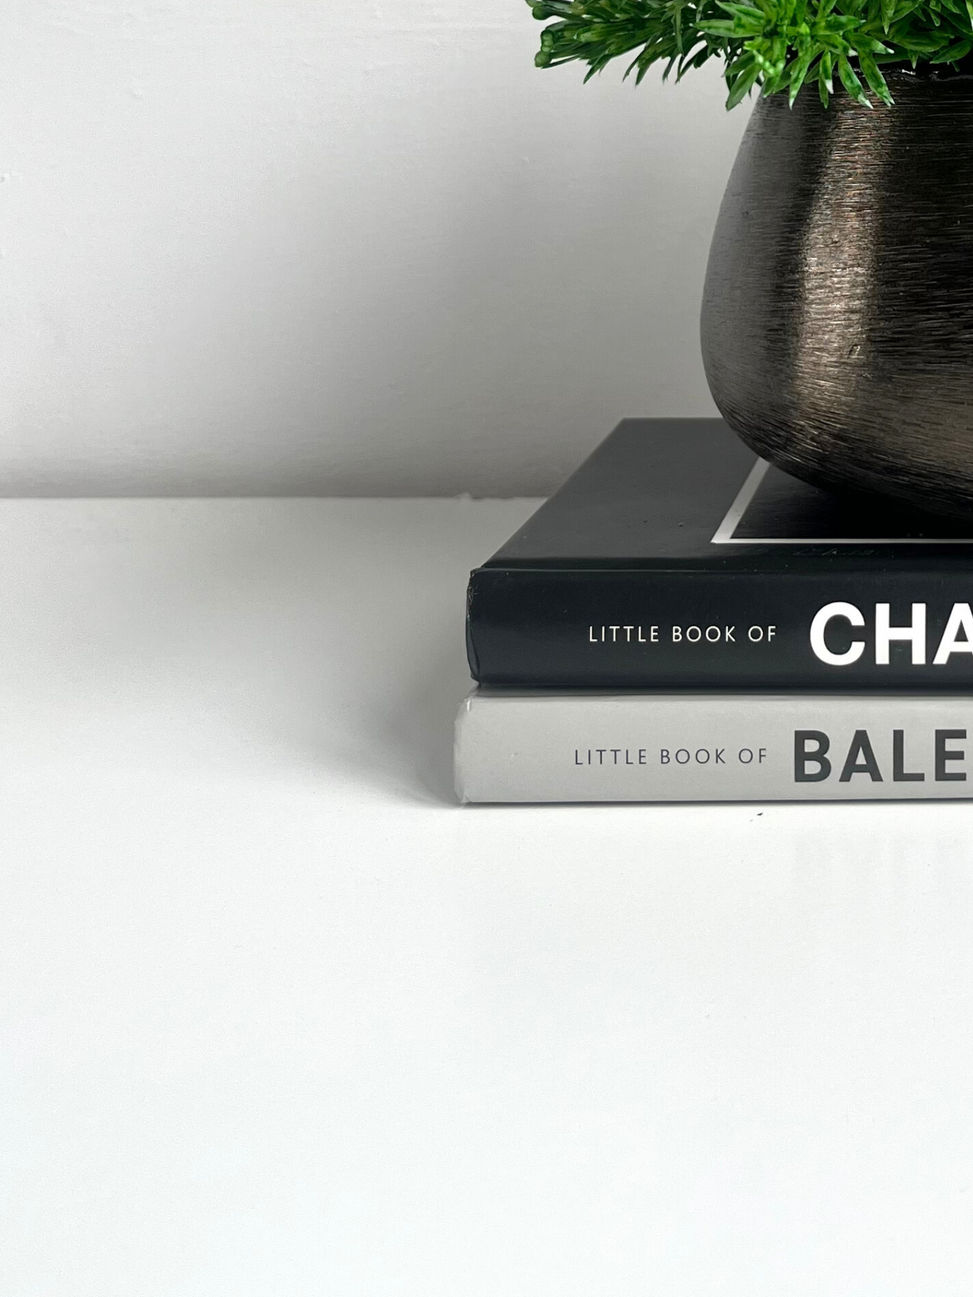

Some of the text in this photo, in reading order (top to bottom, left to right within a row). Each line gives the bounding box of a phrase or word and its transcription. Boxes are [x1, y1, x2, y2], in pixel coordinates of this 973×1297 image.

[589, 625, 776, 643] LITTLE BOOK OF
[575, 747, 767, 766] LITTLE BOOK OF
